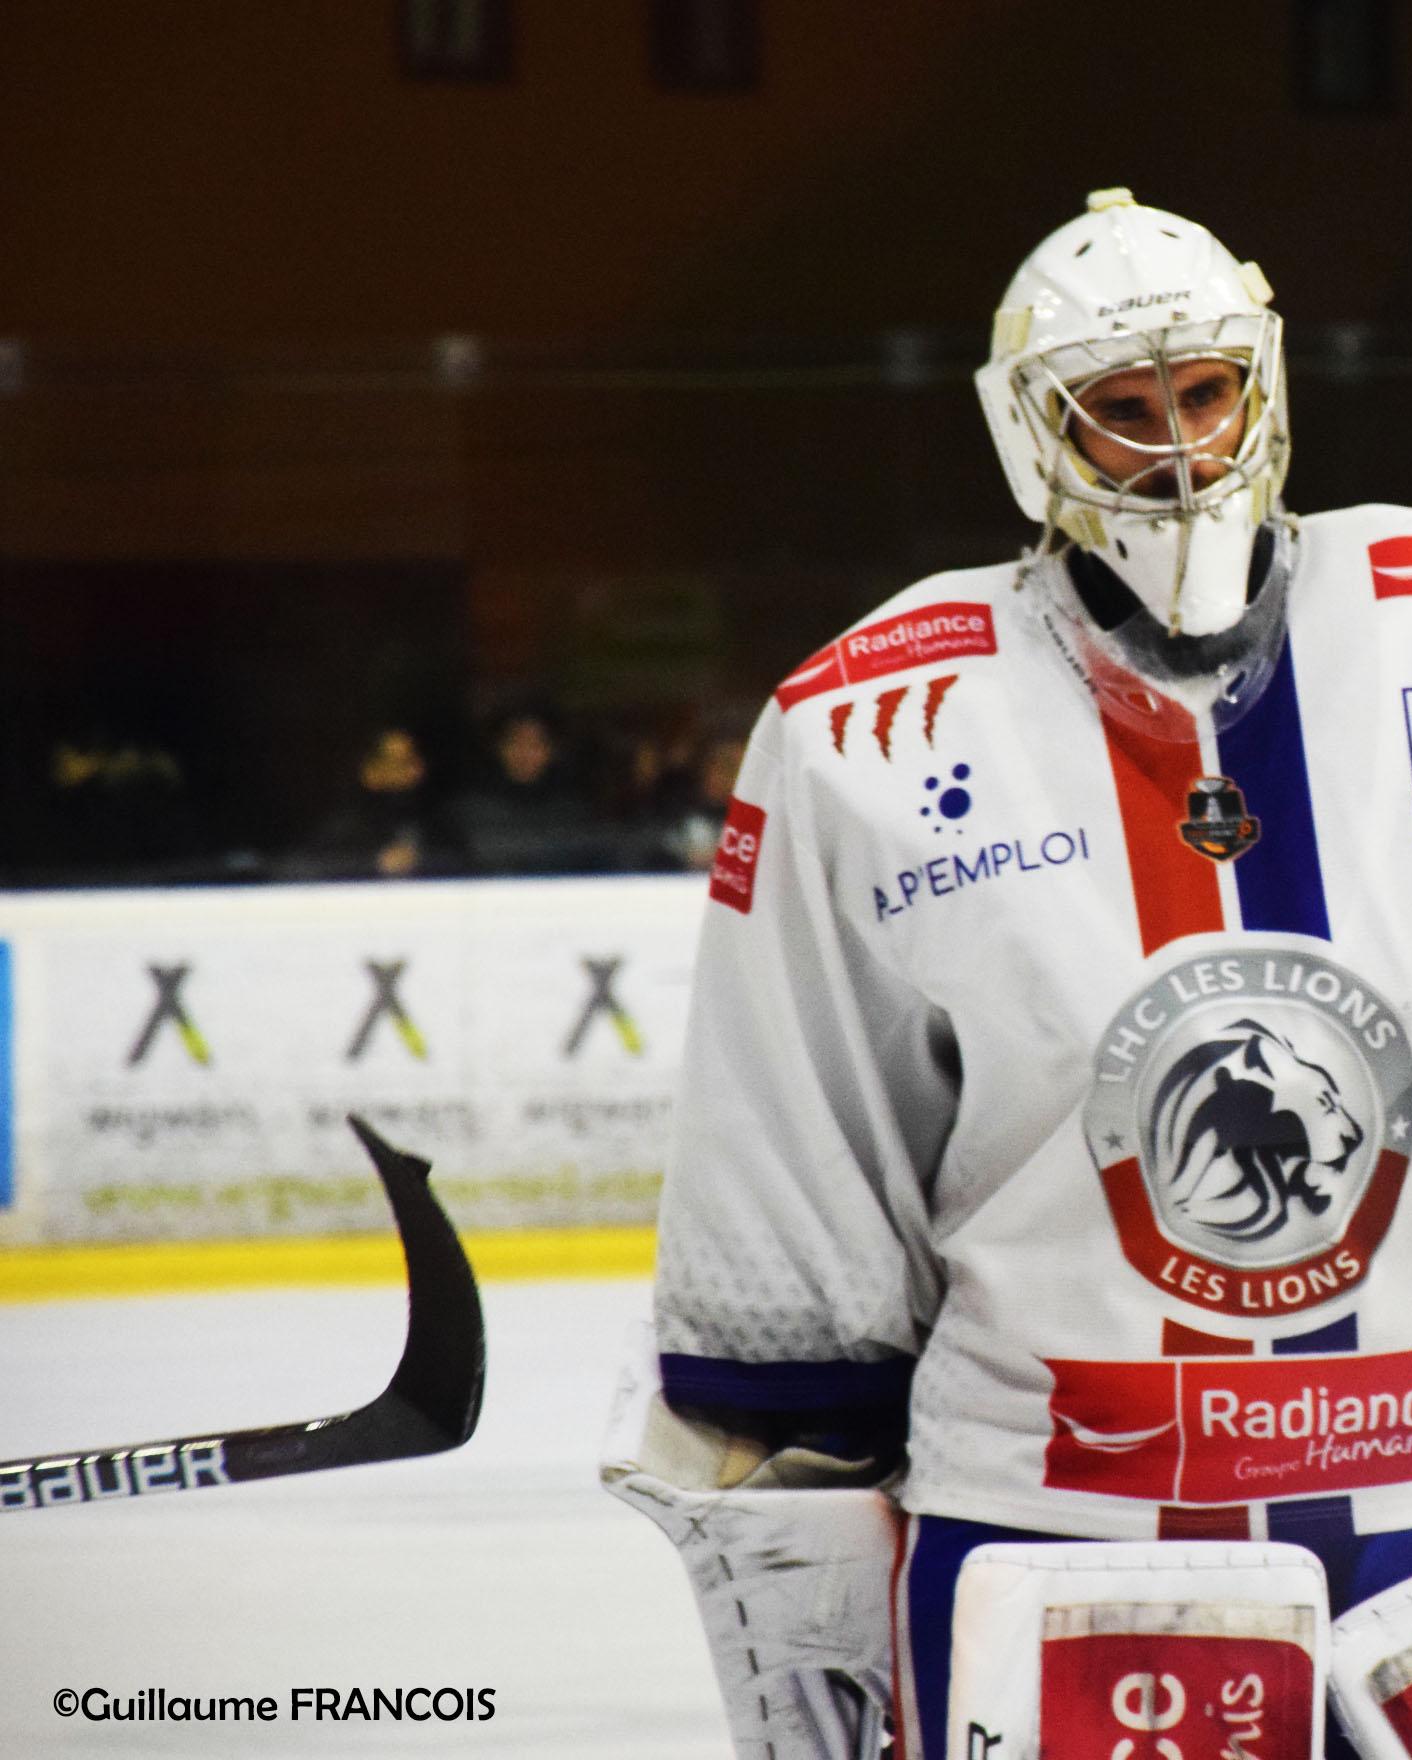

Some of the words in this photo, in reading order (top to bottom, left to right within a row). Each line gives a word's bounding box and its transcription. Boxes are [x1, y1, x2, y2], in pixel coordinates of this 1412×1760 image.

[848, 615, 985, 658] Radiance
[1101, 999, 1168, 1083] LHC
[1168, 960, 1246, 1000] LES
[1263, 959, 1397, 1051] LIONS
[1160, 1256, 1227, 1302] LES
[1241, 1249, 1362, 1310] LIONS
